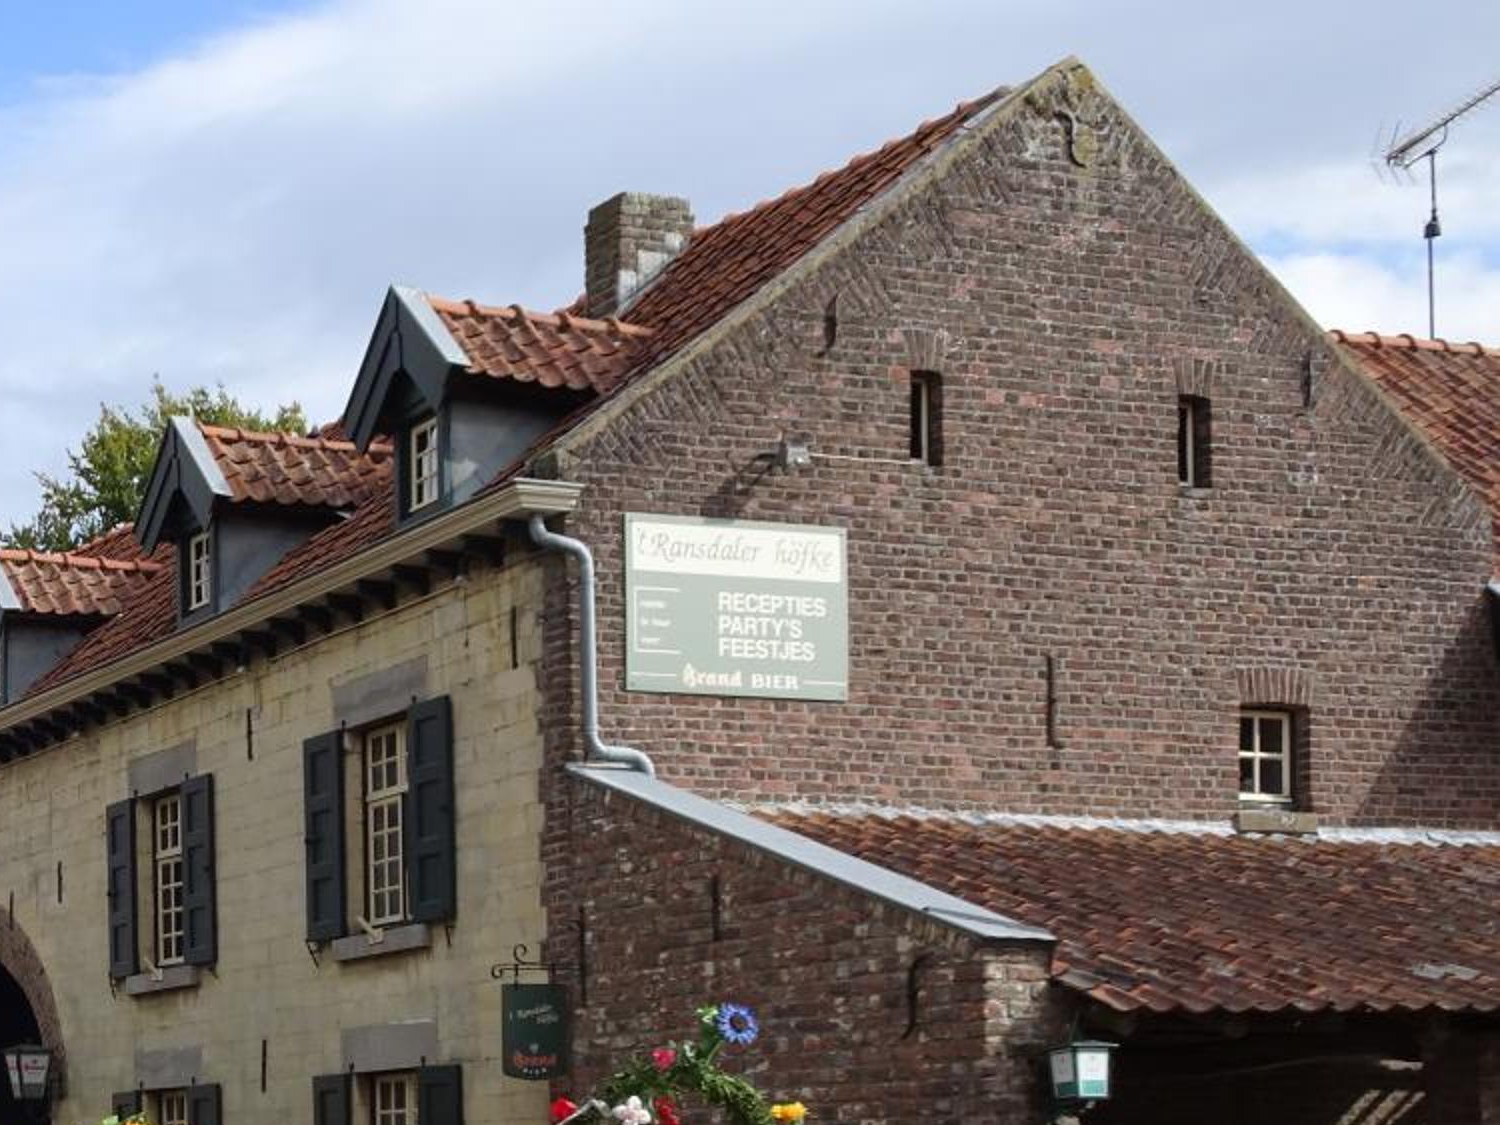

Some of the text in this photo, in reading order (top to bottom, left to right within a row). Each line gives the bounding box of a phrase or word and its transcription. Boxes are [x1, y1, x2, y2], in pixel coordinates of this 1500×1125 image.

[650, 530, 761, 563] Ransdaler
[717, 591, 827, 618] RECEPTIES
[717, 614, 803, 639] PARTY'S
[717, 637, 816, 662] FEESTJES
[682, 662, 799, 690] Brand BIER
